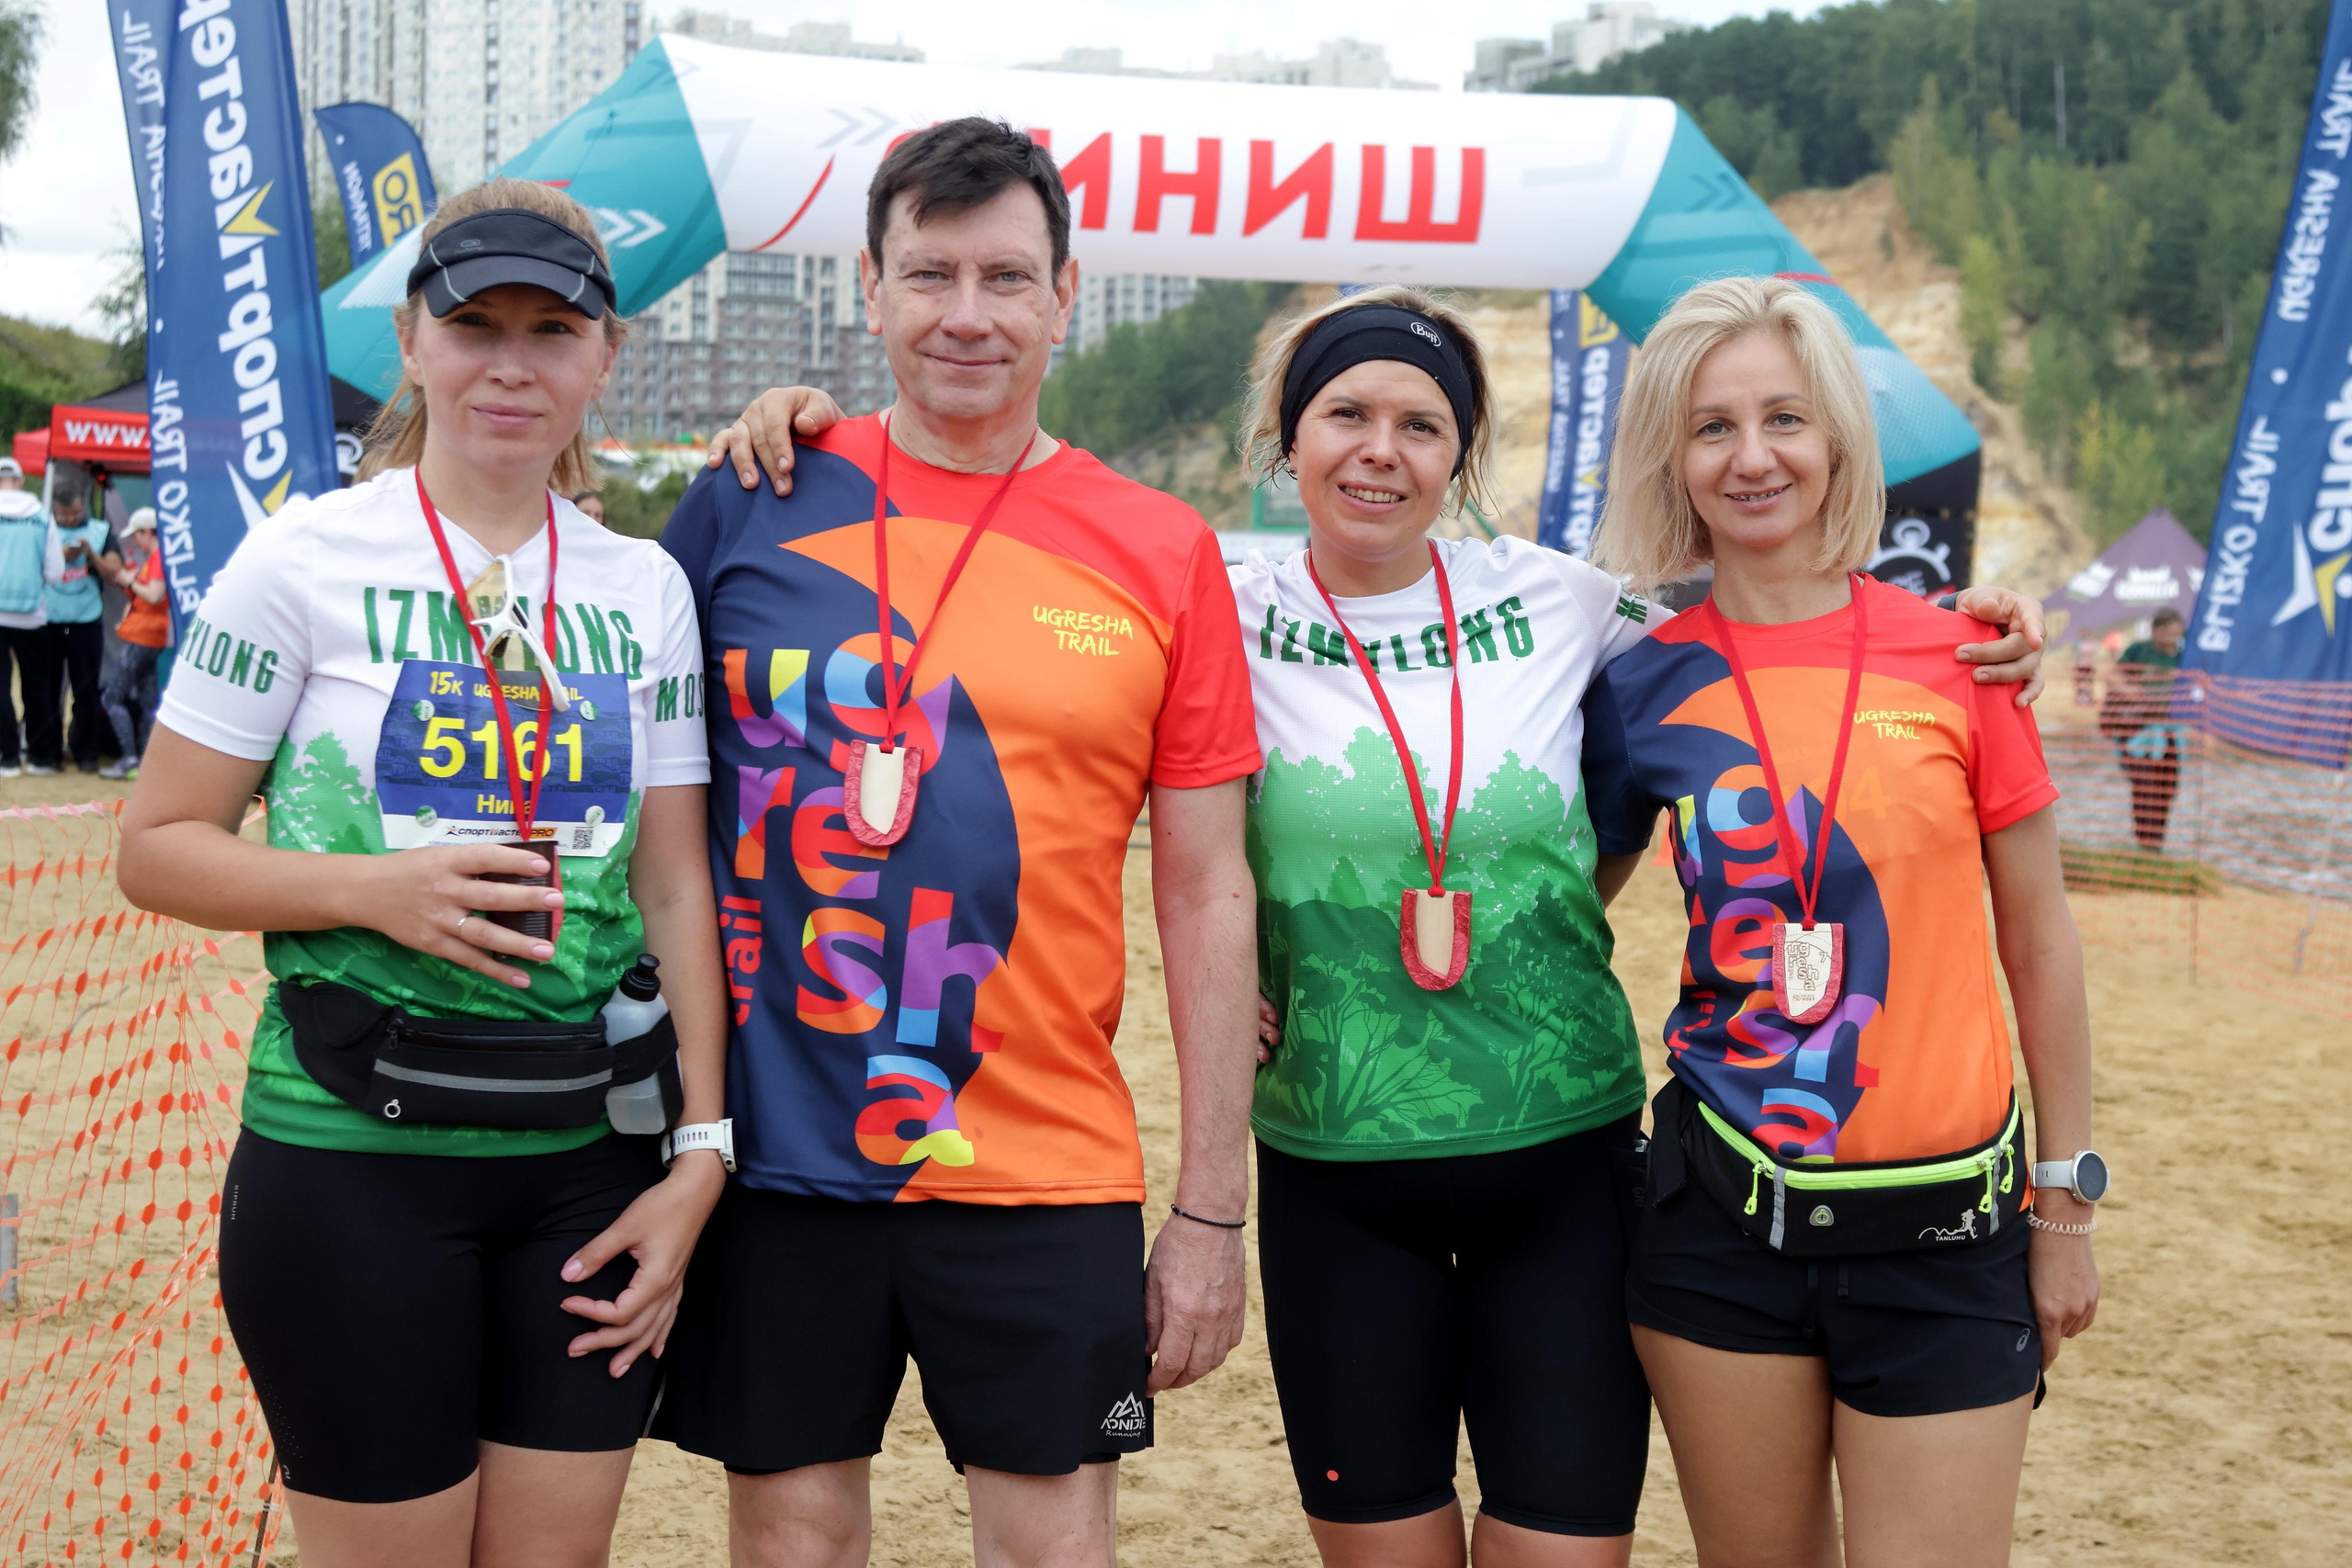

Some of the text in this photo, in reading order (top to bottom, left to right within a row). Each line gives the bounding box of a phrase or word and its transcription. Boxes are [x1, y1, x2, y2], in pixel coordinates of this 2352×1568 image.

[882, 120, 1485, 244] ИНИШ
[1033, 604, 1135, 640] UGRESHA
[1053, 629, 1120, 657] TRAIL
[473, 683, 540, 702] UGESHA
[1854, 710, 1936, 727] UGRESHA
[1871, 722, 1922, 739] TRAIL
[419, 716, 583, 783] 5161
[231, 1185, 239, 1221] KIPRUN
[1105, 1429, 1141, 1438] Running
